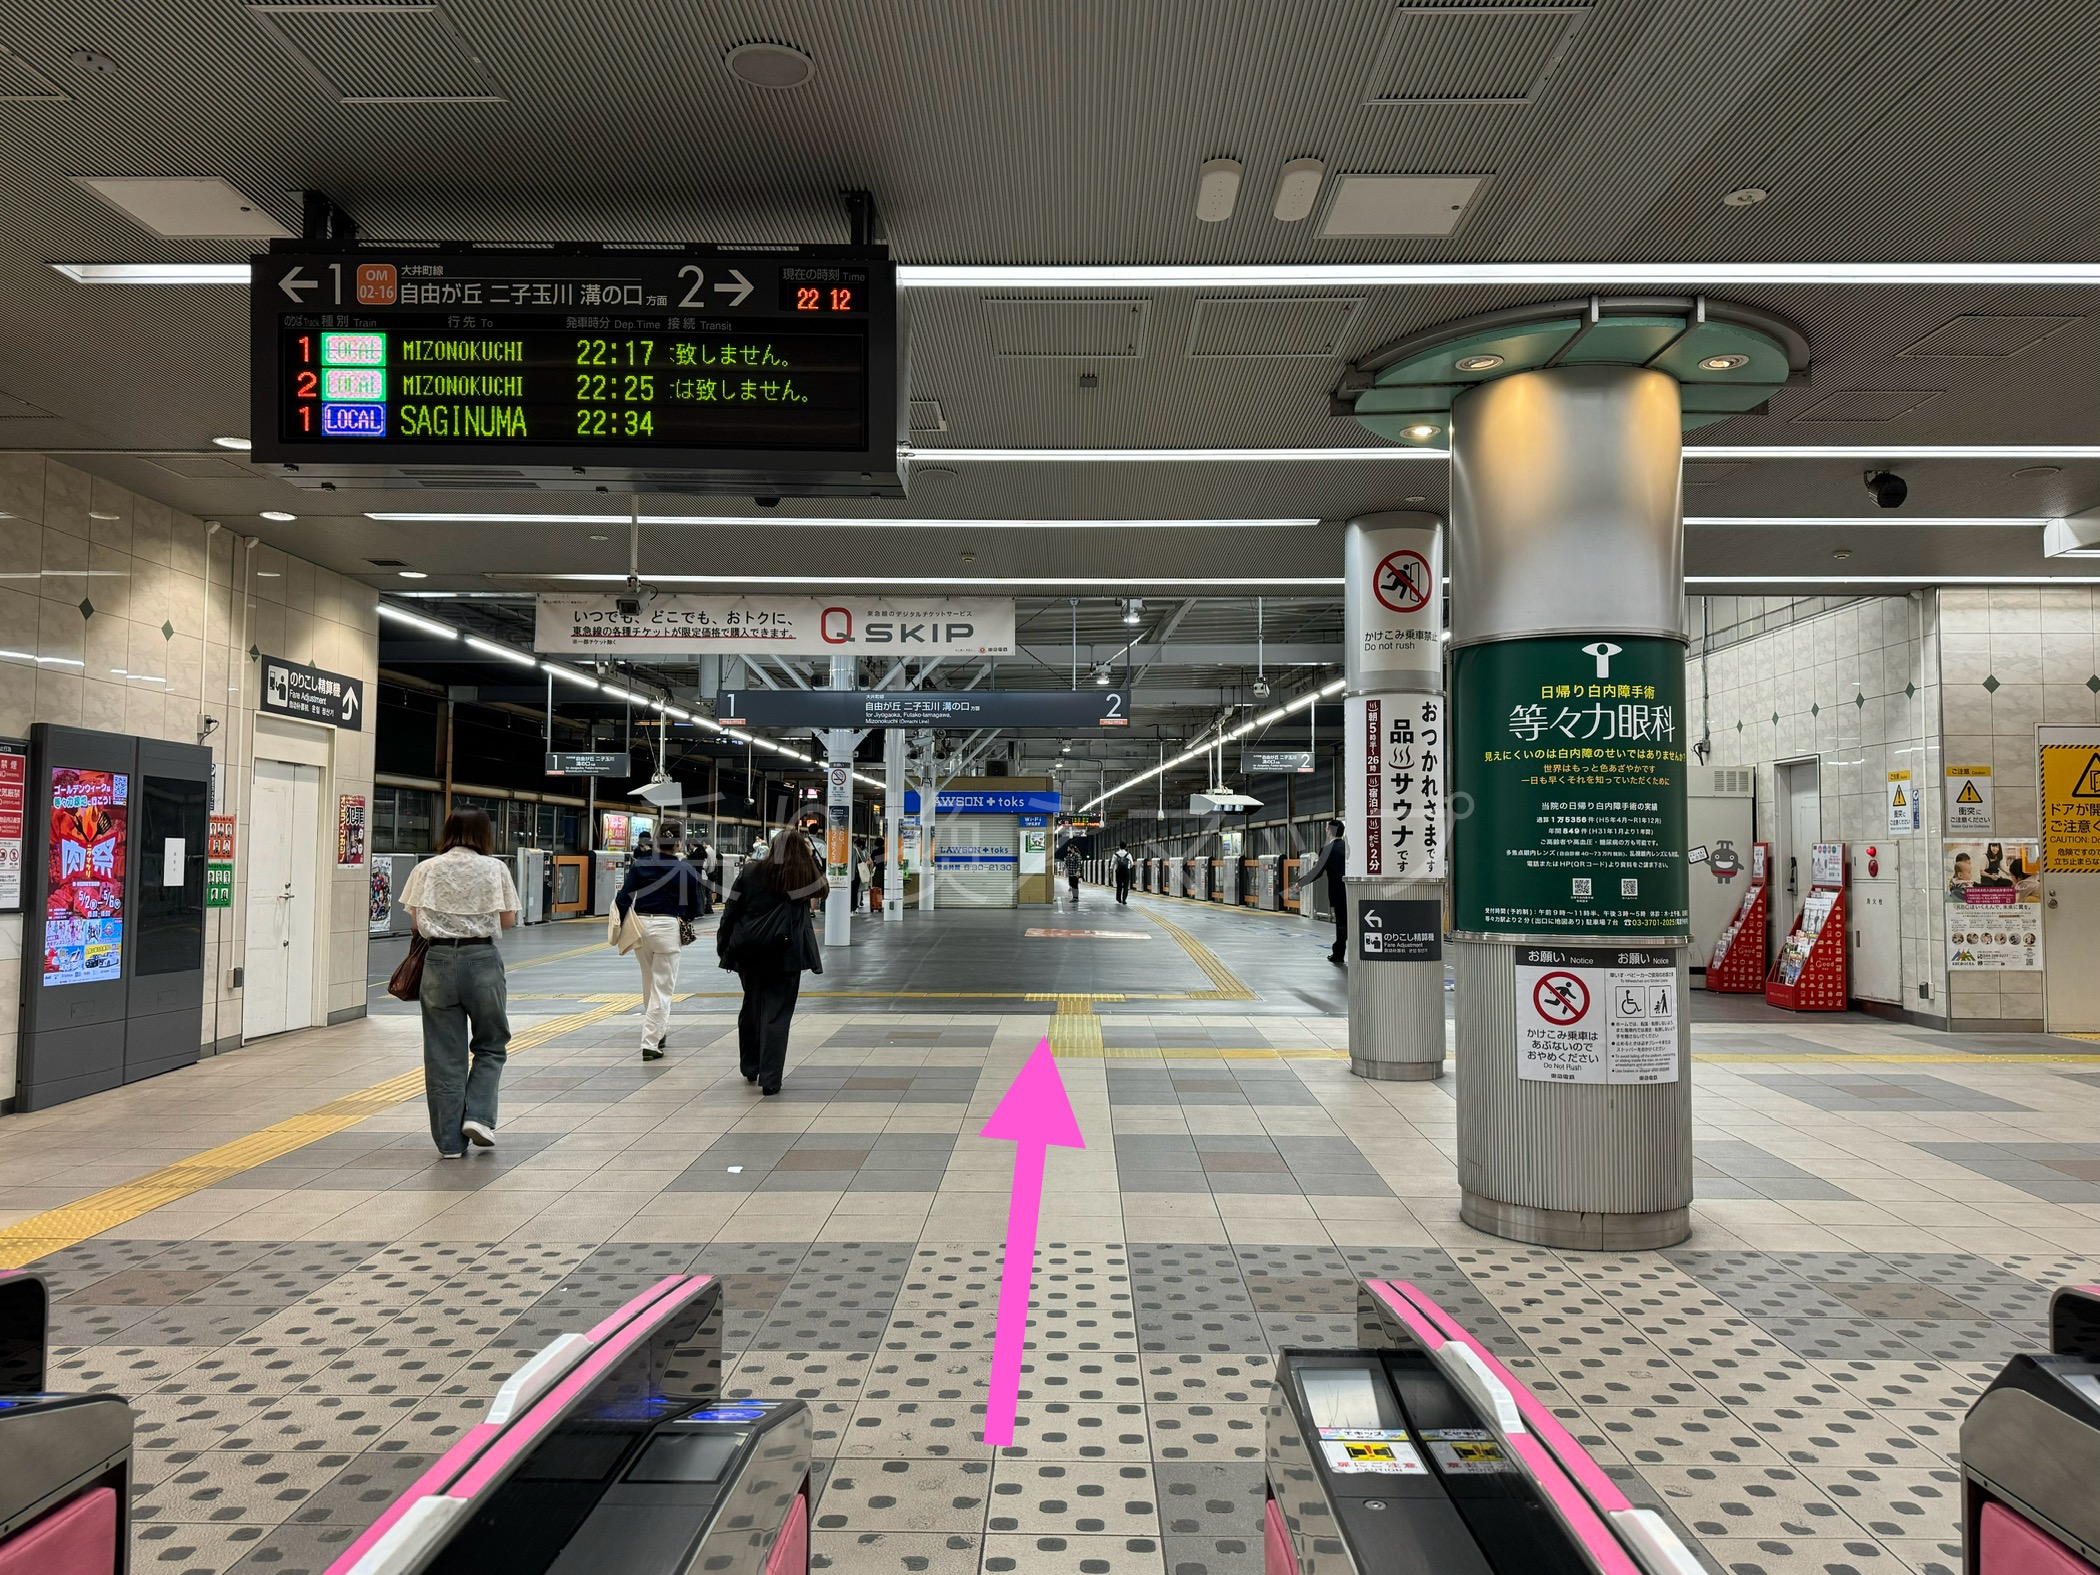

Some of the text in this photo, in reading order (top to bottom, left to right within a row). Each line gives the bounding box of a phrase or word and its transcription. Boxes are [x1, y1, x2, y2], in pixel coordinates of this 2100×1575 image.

[366, 270, 388, 281] OM
[401, 265, 444, 276] 大井町線
[783, 268, 865, 282] 現在の時刻 Time
[329, 264, 341, 305] 1
[678, 265, 704, 307] 2
[359, 285, 394, 299] 02-16
[401, 283, 668, 306] 自由が丘 二子玉川 溝の口 方面
[797, 288, 851, 309] 22 12
[284, 315, 319, 326] のりば Track
[321, 315, 376, 327] 種別 Train
[448, 315, 493, 328] 行先 To
[566, 317, 610, 329] 発車時分
[668, 317, 732, 331] 接続 Transit
[299, 337, 309, 362] 1
[327, 339, 381, 360] LOCAL
[403, 341, 523, 361] MIZONOKUCHI
[577, 340, 654, 365] 22:17
[298, 371, 654, 401] 2 LOCAL MIZONOKUCHI 22:25
[299, 405, 654, 436] 1 LOCAL SAGINUMA 22:34
[573, 626, 794, 638] 東急線の各種チケットが限定価格で購入できます。
[821, 607, 974, 644] Q SKIP
[1365, 629, 1438, 642] かけこみ乗車禁止
[1365, 643, 1376, 651] Do
[290, 672, 341, 698] のりこし精算機
[289, 689, 327, 705] Fare Adjustment
[1541, 685, 1655, 699] 日帰り白内障手術
[727, 694, 735, 717] 1
[866, 702, 901, 711] 自由が丘
[904, 702, 940, 711] 二子玉川
[943, 702, 969, 711] 溝の口
[1106, 693, 1121, 717] 2
[1509, 702, 1676, 743] 等々力眼科
[553, 755, 558, 770] 1
[1300, 754, 1310, 768] 2
[1543, 764, 1655, 773] 世界はもっと色あざやかです
[1421, 701, 1437, 872] おつかれさまです
[1521, 776, 1670, 786] 一日も早くそれを知っていただくために
[934, 796, 1025, 807] AWSON toks
[1541, 802, 1658, 812] 当院の日帰り白内障手術の実績
[346, 804, 364, 826] 犯罪
[1958, 807, 1981, 816] 衝突に
[991, 846, 1009, 854] toks
[1384, 933, 1434, 941] のりこし精算機
[1528, 951, 1594, 965] お願い Notice
[1617, 953, 1650, 965] お願い
[1816, 960, 1834, 968] Good
[1527, 1028, 1598, 1040] かけこみ乗車は
[1532, 1040, 1593, 1052] あぶないので
[1527, 1051, 1599, 1063] おやめください
